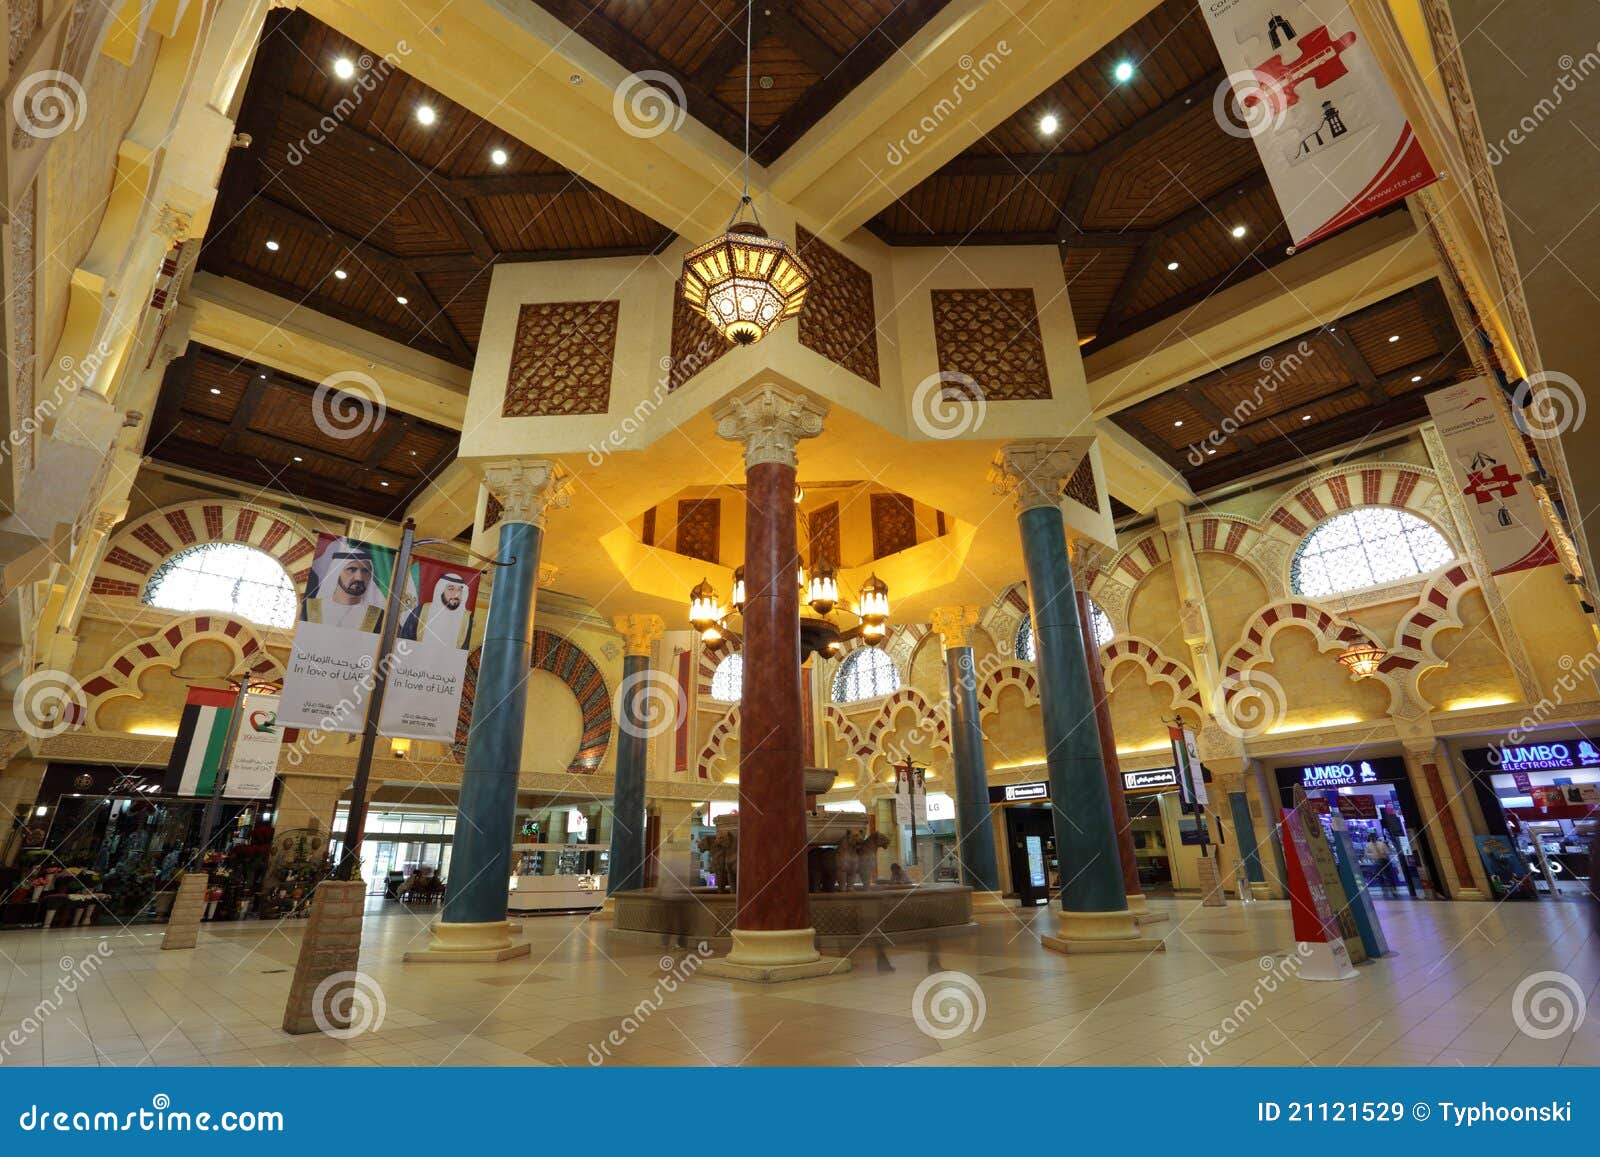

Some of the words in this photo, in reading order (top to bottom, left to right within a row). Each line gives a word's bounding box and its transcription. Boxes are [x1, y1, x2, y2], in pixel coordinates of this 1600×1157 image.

[1368, 172, 1422, 202] www.rta.ae
[294, 664, 303, 673] In
[307, 665, 327, 677] love
[330, 670, 340, 679] of
[393, 680, 402, 688] In
[405, 680, 424, 690] love
[426, 684, 435, 692] of
[437, 685, 455, 696] UAE
[1501, 744, 1569, 764] JUMBO
[1502, 758, 1574, 771] ELECTRONICS
[1303, 764, 1354, 781] JUMBO
[1303, 777, 1357, 787] ELECTRONICS
[928, 803, 940, 812] LG
